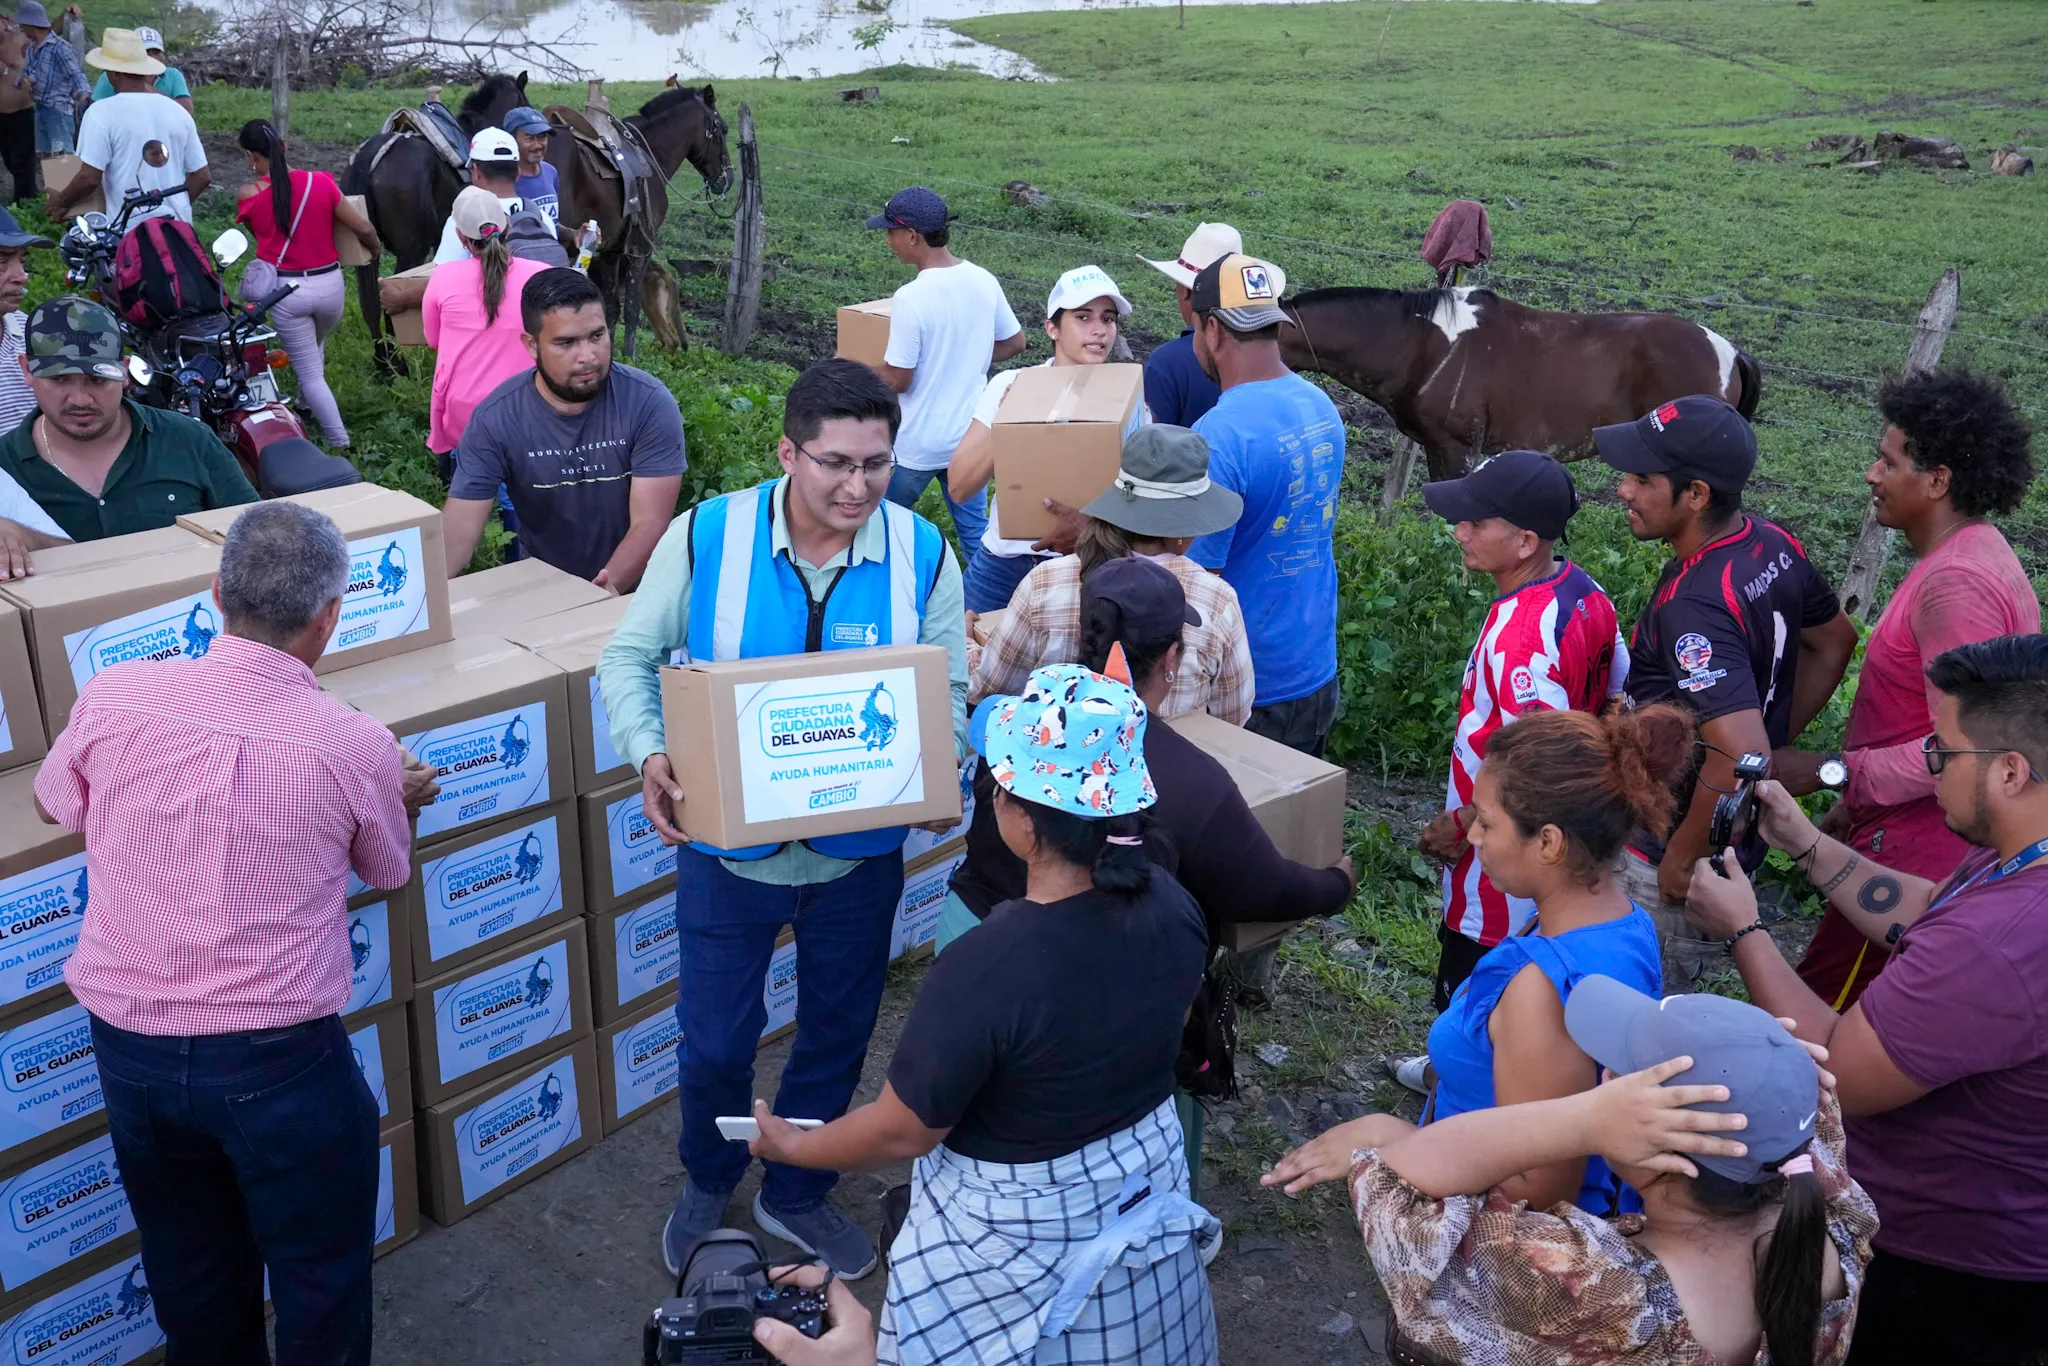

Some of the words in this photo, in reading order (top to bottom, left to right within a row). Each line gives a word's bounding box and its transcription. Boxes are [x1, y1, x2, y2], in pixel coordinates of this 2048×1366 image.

[344, 579, 376, 595] AYAS
[341, 599, 405, 621] HUMANITARIA
[100, 626, 177, 658] PREFECTURA
[339, 626, 376, 646] CAMBIO
[1516, 691, 1536, 700] LaLiga
[770, 702, 854, 720] PREFECTURA
[771, 715, 855, 734] CIUDADANA
[428, 735, 496, 760] PREFECTURA
[772, 733, 799, 747] DEL
[802, 727, 856, 744] GUAYAS
[429, 744, 497, 768] CIUDADANA
[436, 766, 453, 777] EL
[454, 753, 498, 772] GUAYAS
[769, 766, 811, 782] AYUDA
[813, 758, 894, 776] HUMANITARIA
[434, 790, 460, 804] YUDA
[462, 771, 527, 796] HUMANITARIA
[809, 787, 857, 809] CAMBIO
[459, 799, 496, 820] CAMBIO
[630, 829, 648, 841] DEL
[447, 853, 511, 883] PREFECTURA
[629, 850, 655, 865] AYUDA
[449, 862, 512, 892] CIUDADANA
[449, 890, 471, 901] DEL
[472, 870, 513, 892] GUAYAS
[904, 877, 944, 900] PREFECTURA
[0, 885, 65, 915] FECTURA
[448, 910, 479, 927] AYUDA
[481, 885, 541, 914] HUMANITARIA
[904, 885, 944, 907] CIUDADANA
[904, 903, 919, 916] DEL
[918, 891, 944, 908] GUAYAS
[0, 895, 69, 927] DADANA
[11, 905, 71, 935] GUAYAS
[478, 913, 514, 938] CAMBIO
[635, 939, 652, 952] DEL
[654, 926, 679, 942] GUAYA
[902, 920, 921, 934] AYUDA
[26, 934, 79, 961] HUMANI
[26, 964, 64, 990] CAMB
[633, 958, 658, 975] AYUDA
[773, 959, 796, 975] PREFE
[458, 978, 521, 1008] PREFECTURA
[774, 978, 790, 990] DEL
[460, 987, 522, 1017] CIUDADANA
[460, 1014, 481, 1026] DEL
[483, 995, 523, 1017] GUAYAS
[772, 994, 796, 1011] AYUDA
[458, 1034, 489, 1050] AYUDA
[491, 1008, 550, 1038] HUMANITARIA
[632, 1022, 678, 1050] PREFECTUR
[11, 1026, 89, 1063] PREFECTUR
[13, 1035, 92, 1072] CIUDADAN
[16, 1067, 46, 1084] DEL
[47, 1045, 95, 1070] GUAYA
[634, 1053, 650, 1066] DEL
[632, 1070, 656, 1088] AYUDA
[17, 1089, 61, 1113] AYUDA
[62, 1093, 105, 1121] CAMBI
[477, 1096, 534, 1132] PREFECTURA
[479, 1104, 535, 1140] CIUDADANA
[480, 1135, 499, 1149] DEL
[500, 1111, 537, 1137] GUAYAS
[479, 1152, 507, 1172] AYUDA
[508, 1120, 562, 1155] HUMANITARIA
[20, 1160, 106, 1205] PREFECTURA
[22, 1170, 109, 1214] CIUDADANA
[25, 1207, 54, 1225] DEL
[56, 1177, 111, 1209] GUAYAS
[26, 1226, 69, 1252] AYUDA
[70, 1222, 117, 1257] CAMBIO
[24, 1292, 110, 1339] PREFECTURA
[26, 1300, 113, 1347] CIUDADANA
[27, 1339, 57, 1358] DEL
[59, 1309, 114, 1341] GUAYAS
[71, 1316, 154, 1362] HUMANITARIA
